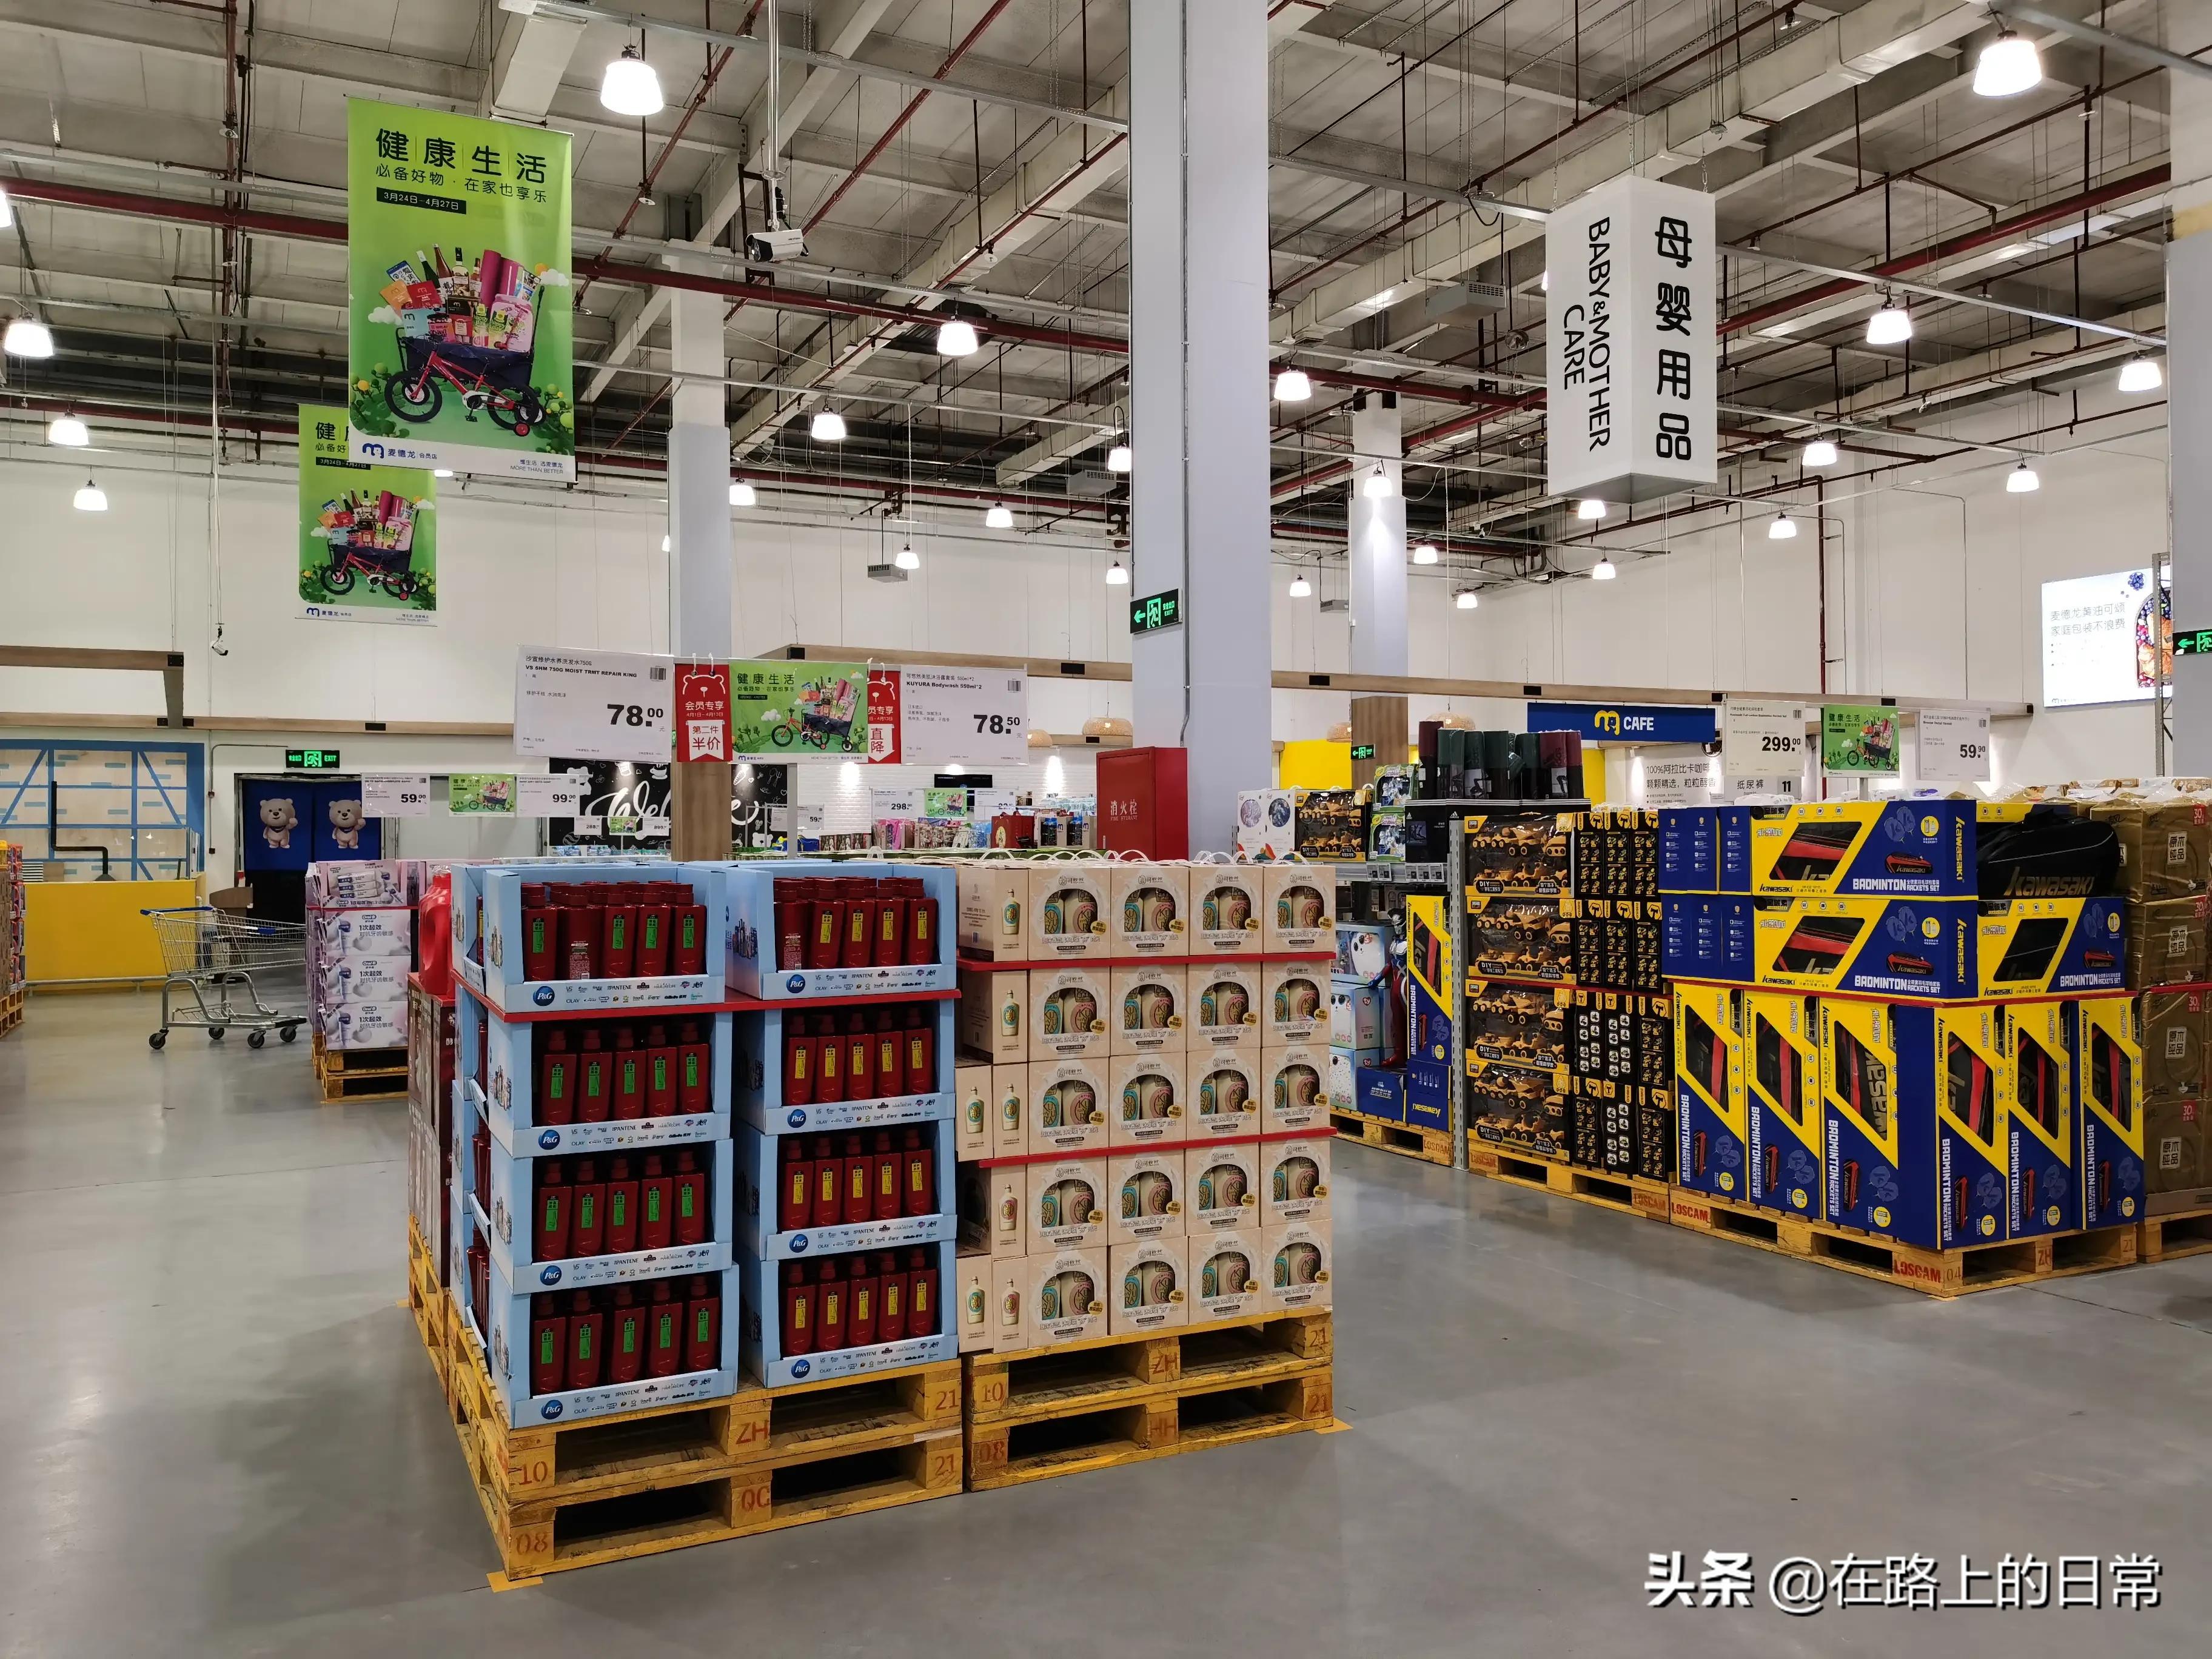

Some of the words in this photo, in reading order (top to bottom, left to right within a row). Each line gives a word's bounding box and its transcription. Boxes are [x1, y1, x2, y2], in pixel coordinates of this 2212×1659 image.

[376, 128, 546, 184] 健康生活
[1655, 216, 1692, 460] 母婴用品
[1564, 304, 1584, 390] CARE
[2051, 618, 2125, 637] 家庭包装不浪费
[737, 673, 794, 685] 健康生活
[685, 701, 725, 711] 会员专享
[868, 706, 894, 714] 员专享
[607, 703, 664, 727] 78.00
[1623, 716, 1654, 731] CAFE
[1829, 713, 1860, 723] 健康生活
[692, 726, 719, 734] 第二件
[973, 714, 1021, 734] 78.50
[692, 737, 720, 750] 半价
[1761, 736, 1801, 752] 299.00
[1960, 744, 1986, 759] 59.90
[1737, 779, 1764, 789] 纸尿裤
[1781, 781, 1791, 792] 11
[400, 794, 426, 803] 59.00
[552, 794, 576, 803] 99.00
[1111, 799, 1137, 816] 消火栓
[1852, 879, 1907, 891] BADMINTON
[1854, 975, 1907, 990] BADMINTON
[2060, 973, 2098, 987] BADMINTON
[1681, 1094, 1691, 1150] BADMINTON
[543, 1135, 558, 1144] P&G
[1751, 1106, 1761, 1164] BADMINTON
[1828, 1119, 1839, 1180] BADMINTON
[1942, 1138, 1951, 1203] BADMINTON
[1672, 1202, 1709, 1221] LOSCAM
[793, 1239, 806, 1247] P&G
[2123, 1239, 2135, 1252] 21
[2038, 1249, 2052, 1266] ZH
[545, 1271, 560, 1279] P&G
[1894, 1259, 1941, 1283] LOSCAM
[1946, 1265, 1962, 1281] 04
[1310, 1326, 1329, 1347] 21
[936, 1390, 959, 1411] 21
[981, 1381, 1004, 1403] 10
[1309, 1392, 1329, 1413] 21
[734, 1420, 769, 1446] ZH
[518, 1460, 548, 1486] 10
[935, 1455, 957, 1476] 21
[514, 1530, 549, 1555] 08
